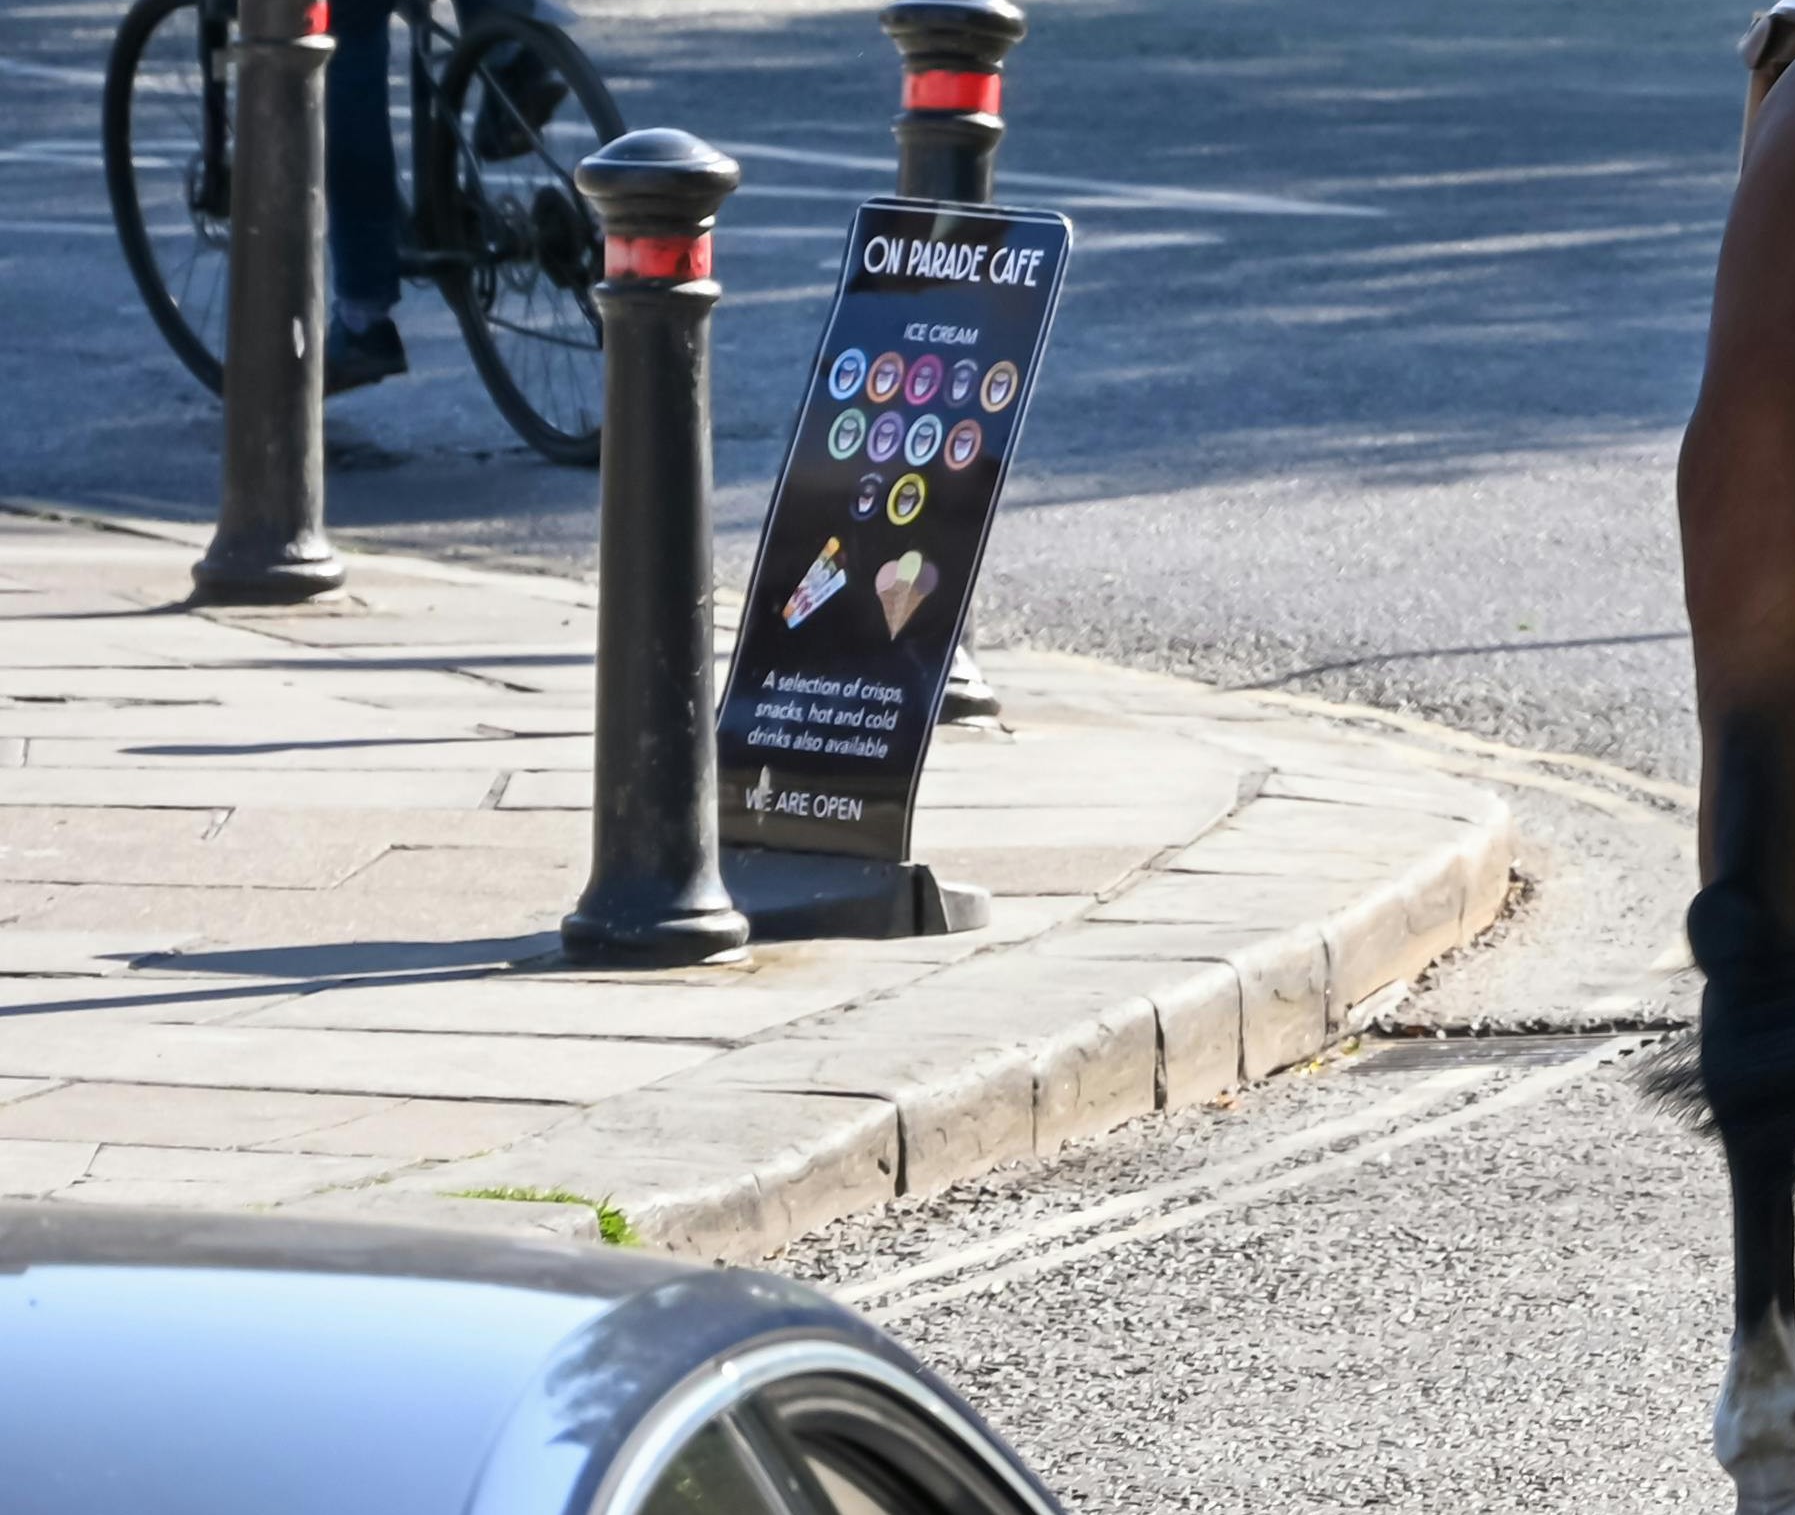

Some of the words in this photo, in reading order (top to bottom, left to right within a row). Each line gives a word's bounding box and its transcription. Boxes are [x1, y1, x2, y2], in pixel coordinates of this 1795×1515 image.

[863, 235, 904, 275] ON
[905, 239, 988, 282] PARADE
[989, 245, 1044, 287] CAFE
[903, 322, 928, 341] ICE
[928, 324, 979, 345] CREAM
[762, 669, 776, 689] A
[777, 672, 840, 696] selection
[842, 677, 862, 699] of
[861, 682, 903, 706] crisps,
[807, 702, 834, 725] hot
[834, 706, 866, 728] and
[865, 709, 899, 731] cold
[747, 725, 792, 749] drinks
[792, 729, 823, 752] also
[824, 735, 889, 759] available
[745, 787, 773, 812] WE
[775, 790, 811, 817] ARE
[812, 794, 863, 822] OPEN
